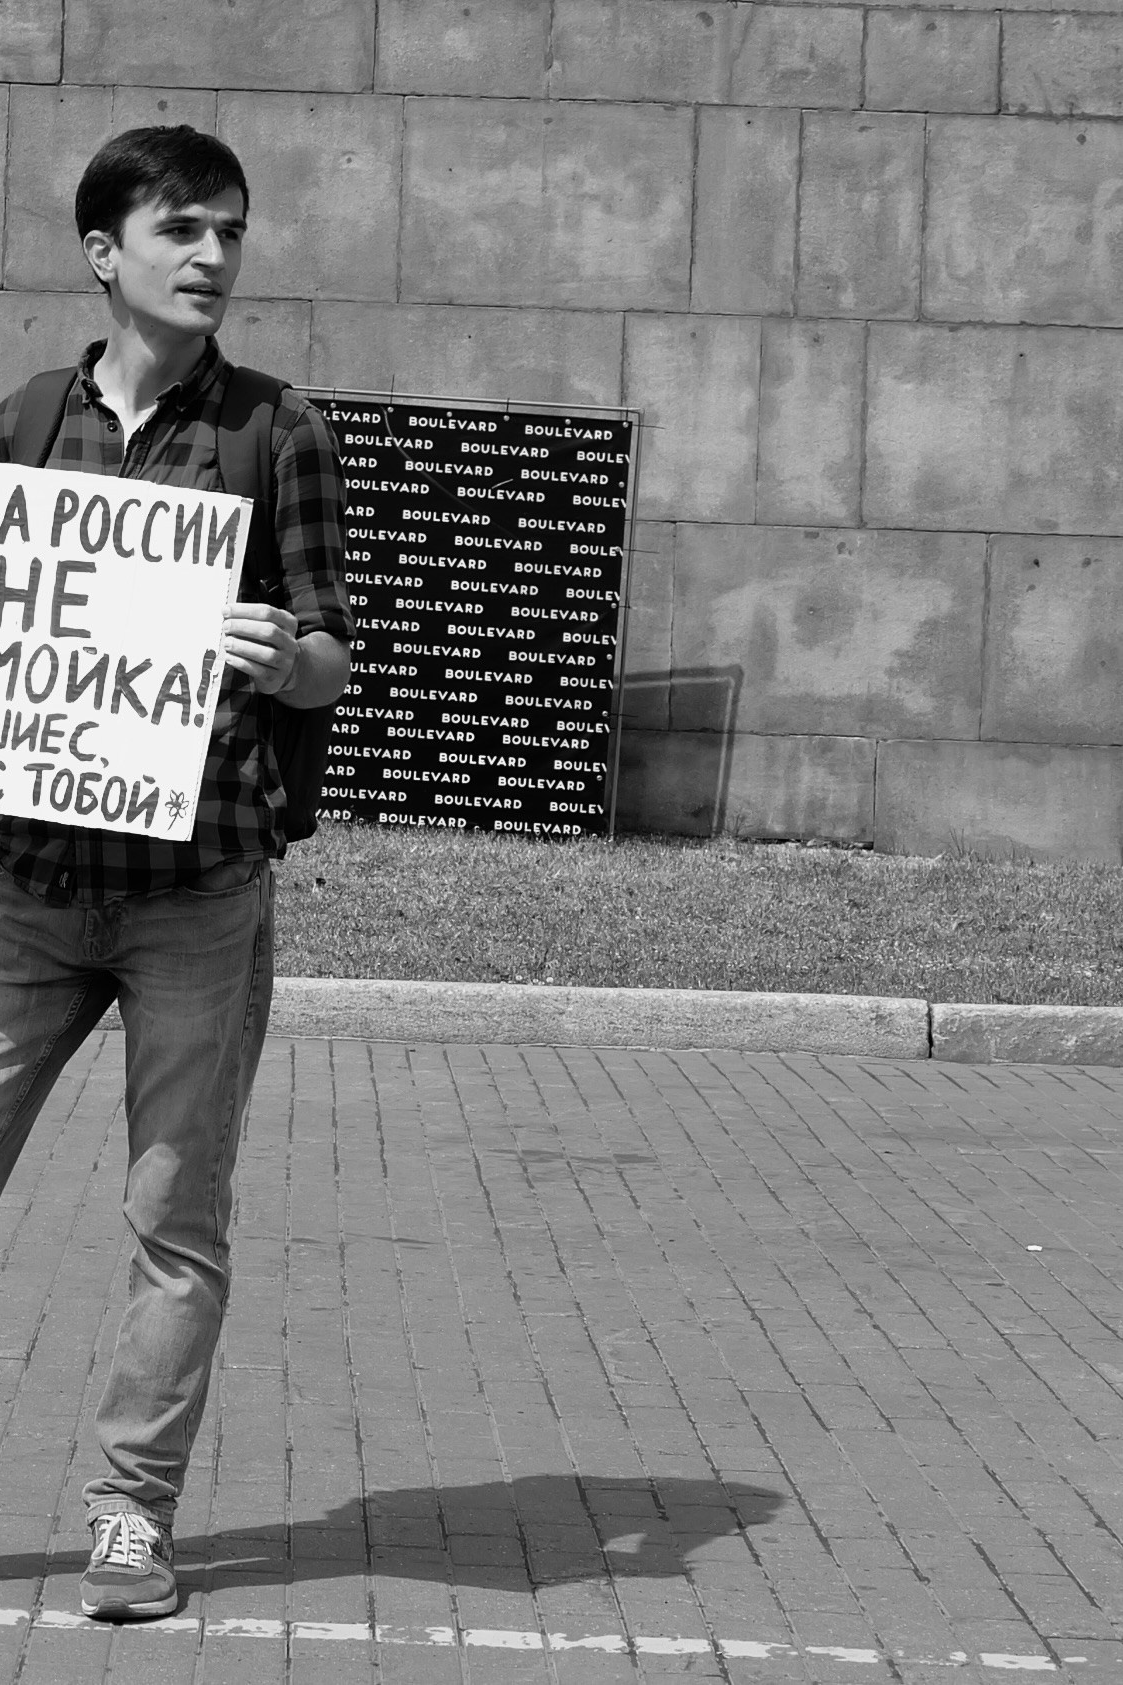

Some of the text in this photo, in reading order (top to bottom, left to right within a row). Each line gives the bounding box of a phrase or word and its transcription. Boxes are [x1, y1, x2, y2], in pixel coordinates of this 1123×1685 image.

[408, 415, 498, 433] BOULEVARD
[524, 424, 613, 441] BOULEVARD
[344, 433, 434, 450] BOULEVARD
[460, 442, 550, 459] BOULEVARD
[404, 460, 494, 477] BOULEVARD
[520, 468, 609, 485] BOULEVARD
[457, 486, 546, 503] BOULEVARD
[49, 488, 242, 570] РОССИИ
[402, 509, 491, 526] BOULEVARD
[517, 517, 606, 534] BOULEVARD
[345, 527, 427, 544] OULEVARD
[454, 535, 543, 552] BOULEVARD
[398, 553, 487, 570] BOULEVARD
[514, 562, 602, 578] BOULEVARD
[450, 579, 539, 596] BOULEVARD
[395, 598, 484, 615] BOULEVARD
[510, 606, 599, 623] BOULEVARD
[447, 624, 536, 640] BOULEVARD
[393, 642, 482, 659] BOULEVARD
[508, 650, 596, 667] BOULEVARD
[444, 668, 533, 684] BOULEVARD
[389, 686, 478, 703] BOULEVARD
[504, 694, 593, 711] BOULEVARD
[441, 712, 530, 729] BOULEVARD
[386, 726, 476, 743] BOULEVARD
[502, 734, 590, 750] BOULEVARD
[438, 752, 527, 768] BOULEVARD
[382, 768, 471, 784] BOULEVARD
[497, 775, 586, 792] BOULEVARD
[22, 761, 160, 830] ТОБОЙ
[321, 786, 407, 802] BOULEVARD
[434, 793, 523, 810] BOULEVARD
[378, 812, 467, 829] BOULEVARD
[493, 819, 582, 836] BOULEVARD
